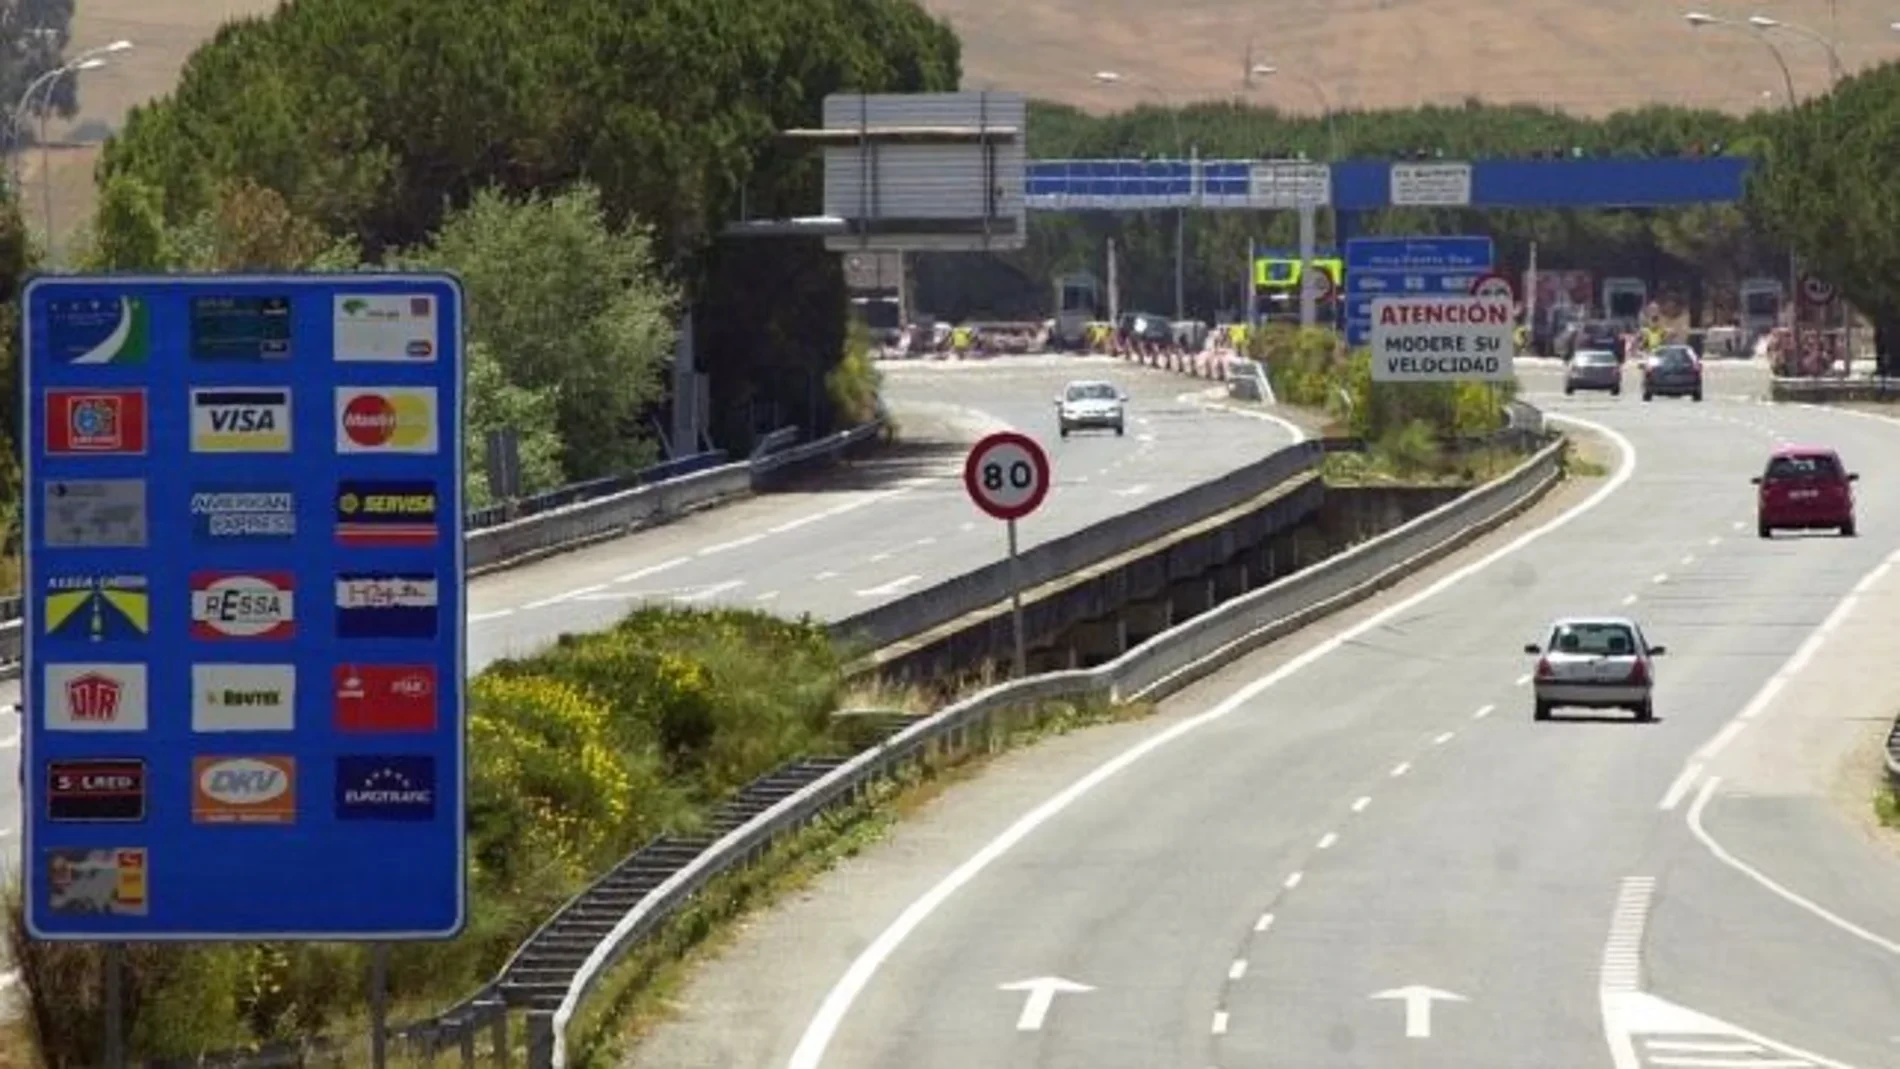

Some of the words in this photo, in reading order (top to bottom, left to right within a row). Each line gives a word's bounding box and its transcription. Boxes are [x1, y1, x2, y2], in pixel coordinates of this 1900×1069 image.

[1380, 301, 1506, 325] ATENCIÓN
[1385, 336, 1466, 352] MODERE
[1475, 336, 1500, 352] SU
[1387, 357, 1499, 373] VELOCIDAD
[210, 409, 275, 432] VISA
[983, 461, 1032, 490] 80
[191, 492, 290, 513] AMERICAN
[205, 589, 281, 621] RESSA
[58, 775, 133, 790] SLRED
[210, 769, 278, 793] DKV
